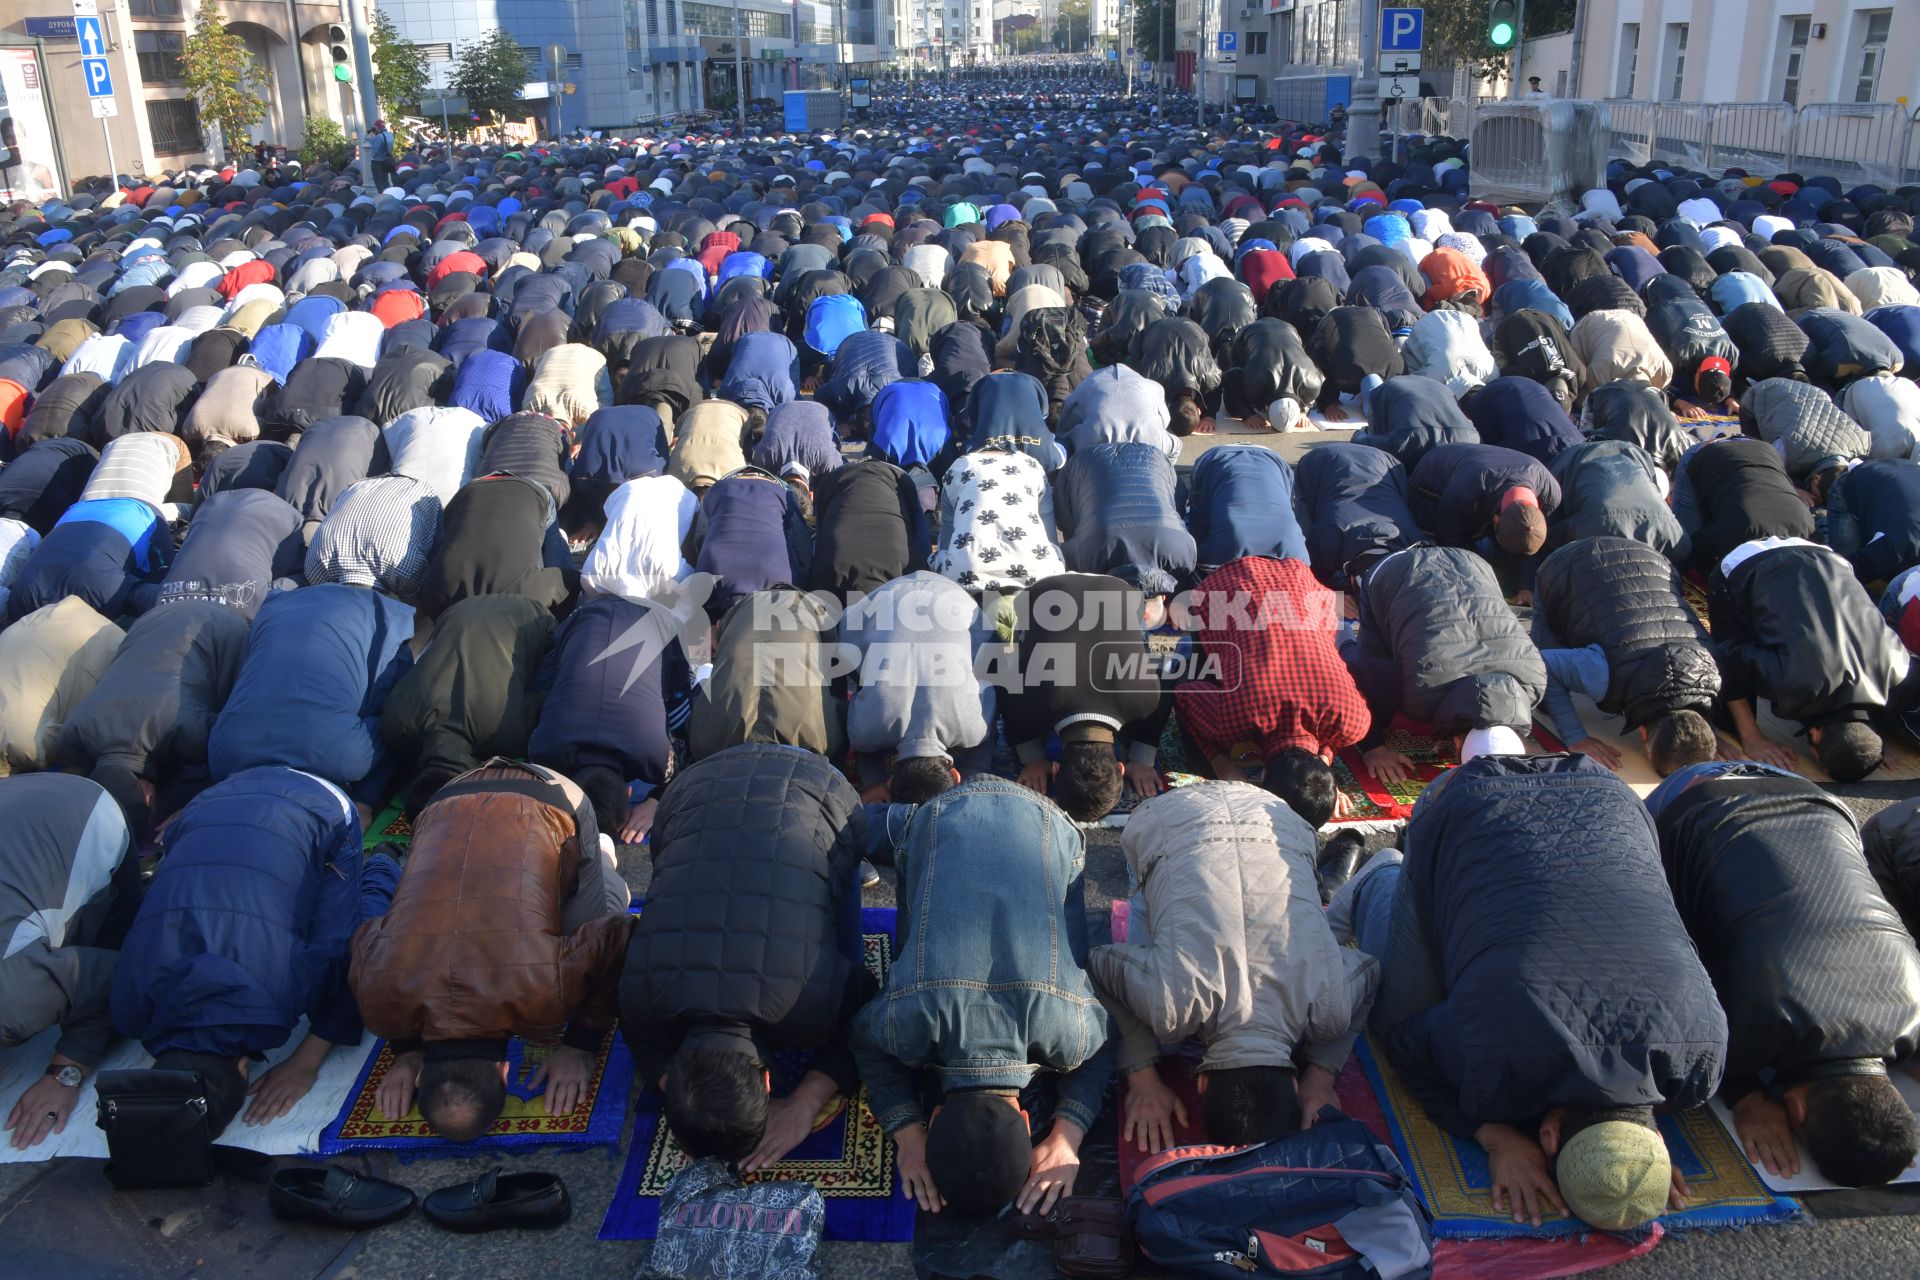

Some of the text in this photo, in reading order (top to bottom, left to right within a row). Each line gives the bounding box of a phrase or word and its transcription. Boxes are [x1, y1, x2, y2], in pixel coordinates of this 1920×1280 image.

[1222, 33, 1234, 49] P
[1392, 13, 1416, 46] P
[89, 62, 107, 93] P
[674, 1200, 804, 1236] FLOWER
